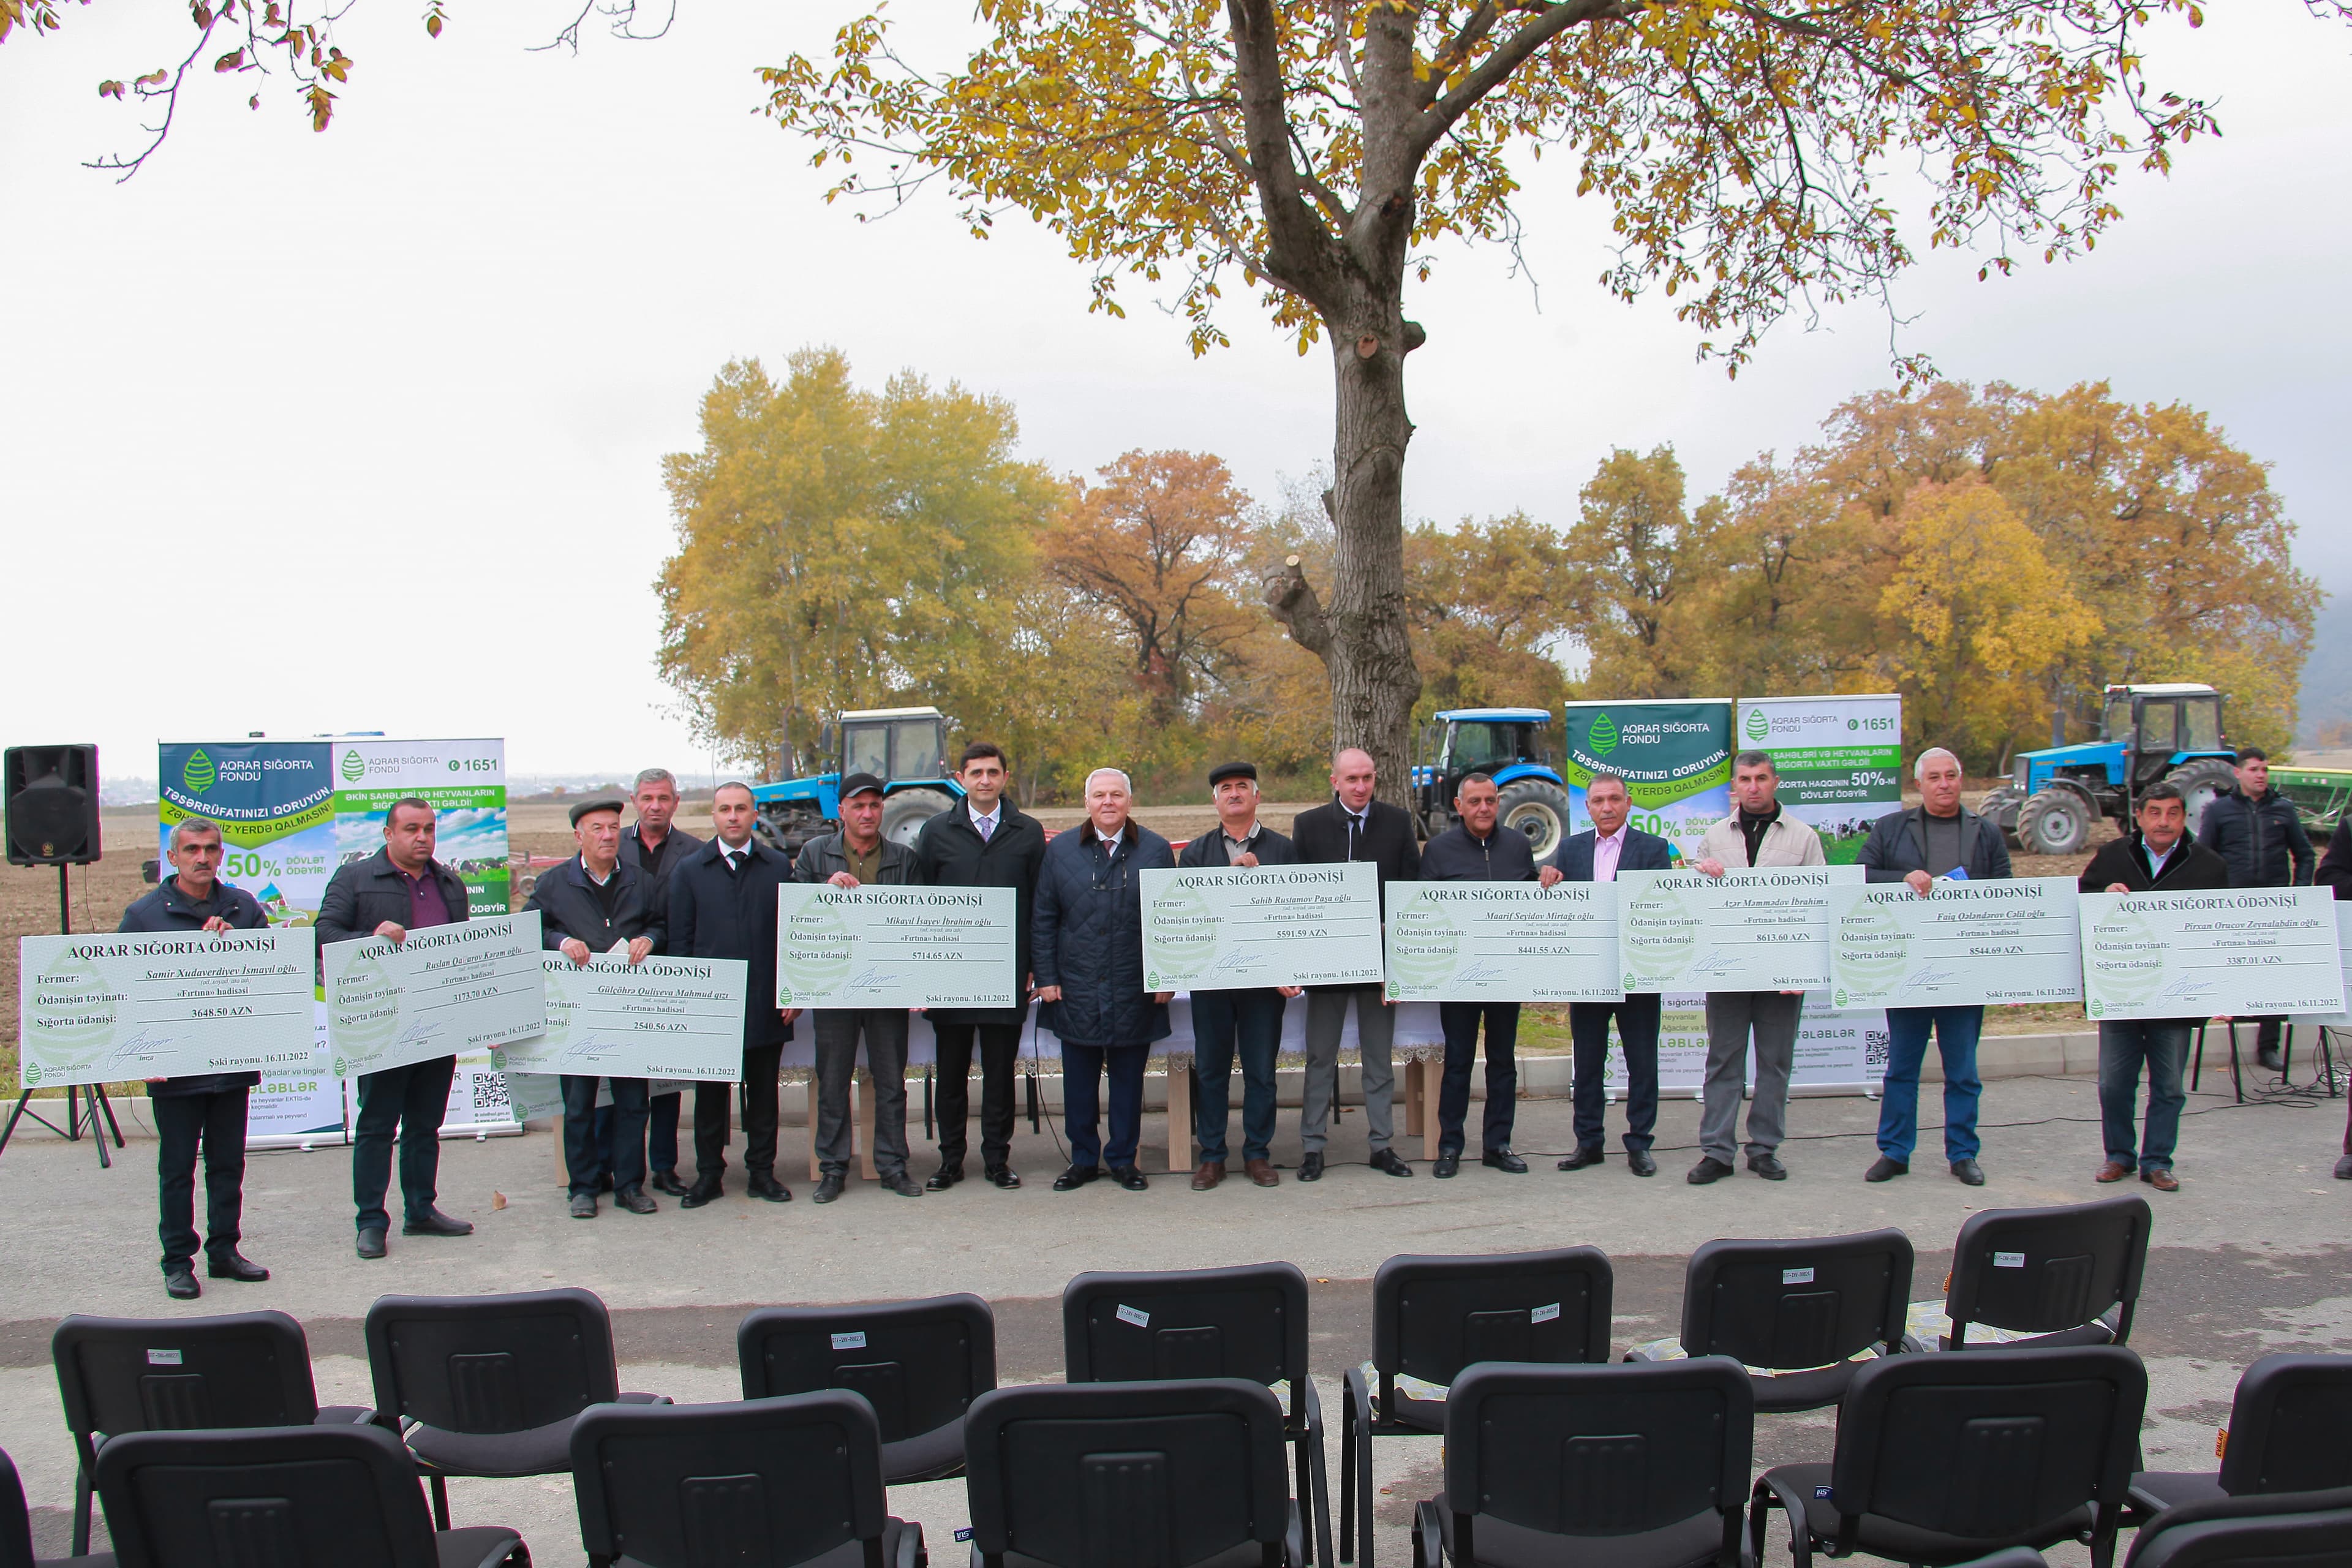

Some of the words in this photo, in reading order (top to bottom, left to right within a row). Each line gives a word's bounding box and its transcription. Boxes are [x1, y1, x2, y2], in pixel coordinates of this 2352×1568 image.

[1803, 715, 1838, 724] SIĞORTA
[1862, 718, 1894, 730] 1651
[1622, 724, 1660, 734] AQRAR
[1662, 722, 1709, 733] SIĞORTA
[1622, 735, 1660, 744] FONDU
[1773, 750, 1817, 759] SAHƏLƏRİ
[1833, 748, 1893, 757] HEYVANLARIN
[220, 761, 261, 771] AQRAR
[263, 758, 314, 770] SIĞORTA
[401, 756, 439, 765] SIĞORTA
[464, 758, 498, 771] 1651
[1672, 748, 1729, 777] QORUYUN,
[1775, 760, 1814, 769] SIĞORTA
[220, 772, 261, 782] FONDU
[1637, 786, 1672, 796] YERDƏ
[1674, 765, 1725, 793] QALMASIN!
[1809, 778, 1849, 788] HAQQININ
[369, 790, 416, 800] SAHƏLƏRİ
[1800, 790, 1834, 799] DÖVLƏT
[1836, 788, 1868, 797] ÖDƏYİR
[165, 786, 269, 818] TƏSƏRRÜFATINIZI
[273, 786, 334, 816] QORUYUN,
[235, 826, 273, 834] YERDƏ
[275, 803, 332, 831] QALMASIN!
[226, 853, 281, 878] 50%
[286, 856, 325, 865] DÖVLƏT
[1175, 875, 1224, 889] AQRAR
[1227, 872, 1287, 886] SIĞORTA
[1288, 869, 1344, 884] ÖDƏNİŞİ
[1653, 878, 1703, 891] AQRAR
[1706, 875, 1768, 888] SIĞORTA
[1770, 872, 1829, 888] ÖDƏNİŞİ
[813, 892, 863, 906] AQRAR
[866, 891, 925, 905] SIĞORTA
[927, 892, 983, 908] ÖDƏNİŞİ
[1333, 893, 1351, 903] oğlu
[1419, 889, 1469, 902] AQRAR
[1471, 888, 1531, 900] SIĞORTA
[1533, 888, 1590, 903] ÖDƏNİŞİ
[1864, 891, 1915, 906] AQRAR
[1983, 884, 2042, 900] ÖDƏNİŞİ
[470, 902, 506, 913] ÖDƏYİR
[2116, 900, 2168, 914] AQRAR
[2170, 897, 2234, 911] SIĞORTA
[2236, 893, 2297, 910] ÖDƏNİŞİ
[1577, 911, 1594, 921] oğlu
[974, 918, 991, 927] oğlu
[1276, 929, 1306, 938] 5591.59
[1308, 928, 1327, 937] AZN
[1756, 933, 1788, 941] 8613.60
[1789, 932, 1810, 941] AZN
[358, 942, 404, 961] AQRAR
[406, 933, 461, 952] SIĞORTA
[462, 921, 512, 943] ÖDƏNİŞİ
[67, 944, 129, 960] AQRAR
[133, 940, 206, 956] SIĞORTA
[209, 935, 275, 954] ÖDƏNİŞİ
[2002, 945, 2023, 954] AZN
[911, 951, 942, 960] 5714.65
[943, 951, 963, 960] AZN
[2260, 955, 2282, 963] AZN
[145, 968, 175, 979] Samir
[176, 966, 240, 979] Xudaverdiyev
[241, 963, 276, 976] İsmayıl
[277, 963, 297, 974] oğlu
[541, 959, 585, 973] QRAR
[588, 960, 650, 975] SIĞORTA
[652, 962, 712, 980] ÖDƏNİŞİ
[37, 974, 79, 984] Fermer:
[37, 993, 83, 1005] Ödənişin
[86, 992, 127, 1005] təyinatı:
[453, 989, 480, 1002] 3173.70
[481, 986, 500, 997] AZN
[191, 1007, 228, 1018] 3648.50
[229, 1005, 252, 1016] AZN
[37, 1017, 74, 1029] Sığorta
[77, 1013, 116, 1025] ödənişi:
[633, 1021, 665, 1030] 2540.56
[208, 1057, 227, 1068] Şəki
[265, 1051, 308, 1063] 16.11.2022
[250, 1082, 318, 1094] ƏLƏBLƏR
[2215, 1432, 2224, 1457] EVALAR
